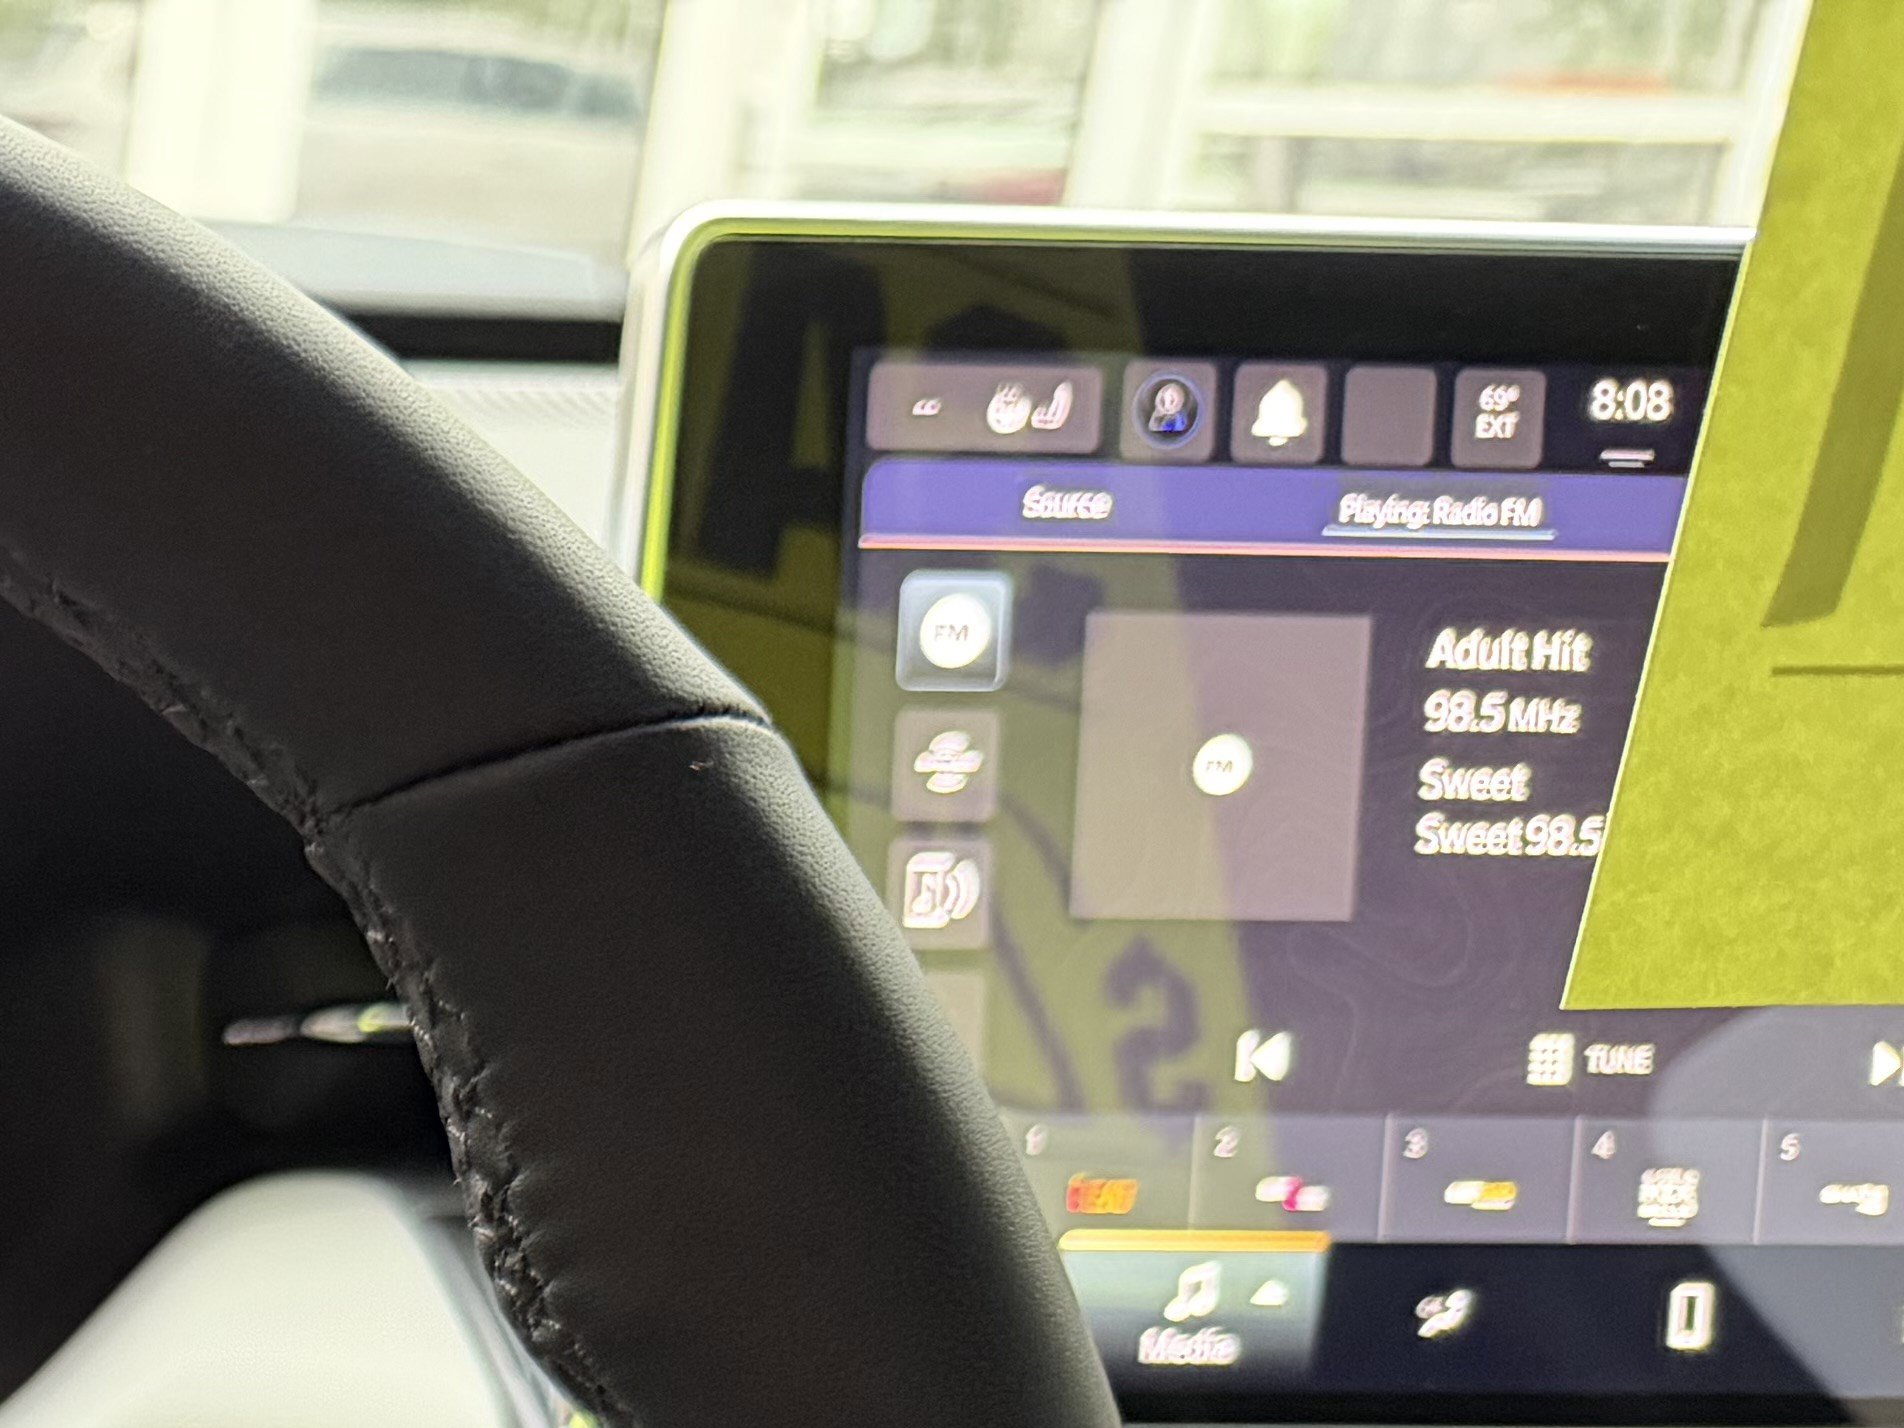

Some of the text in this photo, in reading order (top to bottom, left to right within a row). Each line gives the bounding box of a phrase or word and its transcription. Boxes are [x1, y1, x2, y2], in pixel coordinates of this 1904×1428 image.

[1589, 377, 1674, 422] 8:08
[1474, 411, 1520, 439] EXT
[1021, 484, 1113, 519] Source
[1432, 495, 1498, 527] Radio
[1499, 496, 1544, 528] FM
[1424, 627, 1594, 672] Adult Hit
[1423, 689, 1583, 734] 98.5 MHz
[1417, 758, 1532, 801] Sweet
[1413, 811, 1524, 855] Sweet
[1583, 1043, 1655, 1076] TUNE
[1213, 1125, 1241, 1158] 2
[1403, 1127, 1429, 1160] 3
[1779, 1132, 1802, 1161] 5
